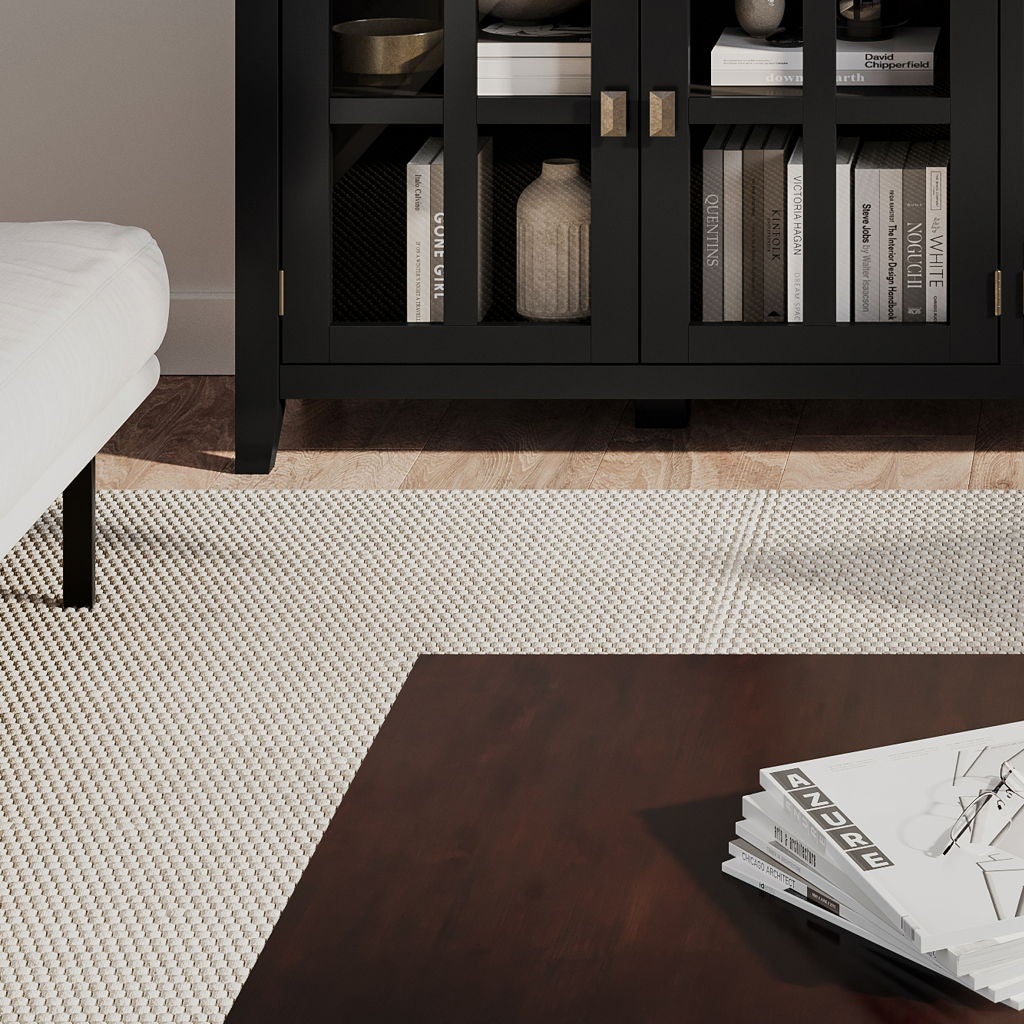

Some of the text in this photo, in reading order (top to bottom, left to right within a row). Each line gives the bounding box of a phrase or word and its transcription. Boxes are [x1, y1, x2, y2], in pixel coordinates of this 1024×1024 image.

[766, 72, 803, 82] down
[865, 61, 929, 70] Chipperfield
[793, 175, 802, 219] VICTORIA
[705, 194, 719, 267] QUENTINS
[772, 209, 781, 261] KINFOLK
[793, 223, 802, 256] HAGAN
[888, 226, 897, 236] The
[433, 212, 445, 299] GONE GIRL
[860, 204, 872, 312] Steve Jobs by Walter Isaacson
[888, 238, 897, 261] Interior
[907, 222, 922, 288] NOGUCHI
[929, 235, 944, 288] WHITE
[886, 263, 897, 285] Design
[888, 286, 897, 320] Handbook
[787, 773, 889, 868] AZURE
[742, 852, 766, 872] CHICAGO
[766, 866, 796, 888] ARCHITECT
[790, 837, 816, 868] architecture
